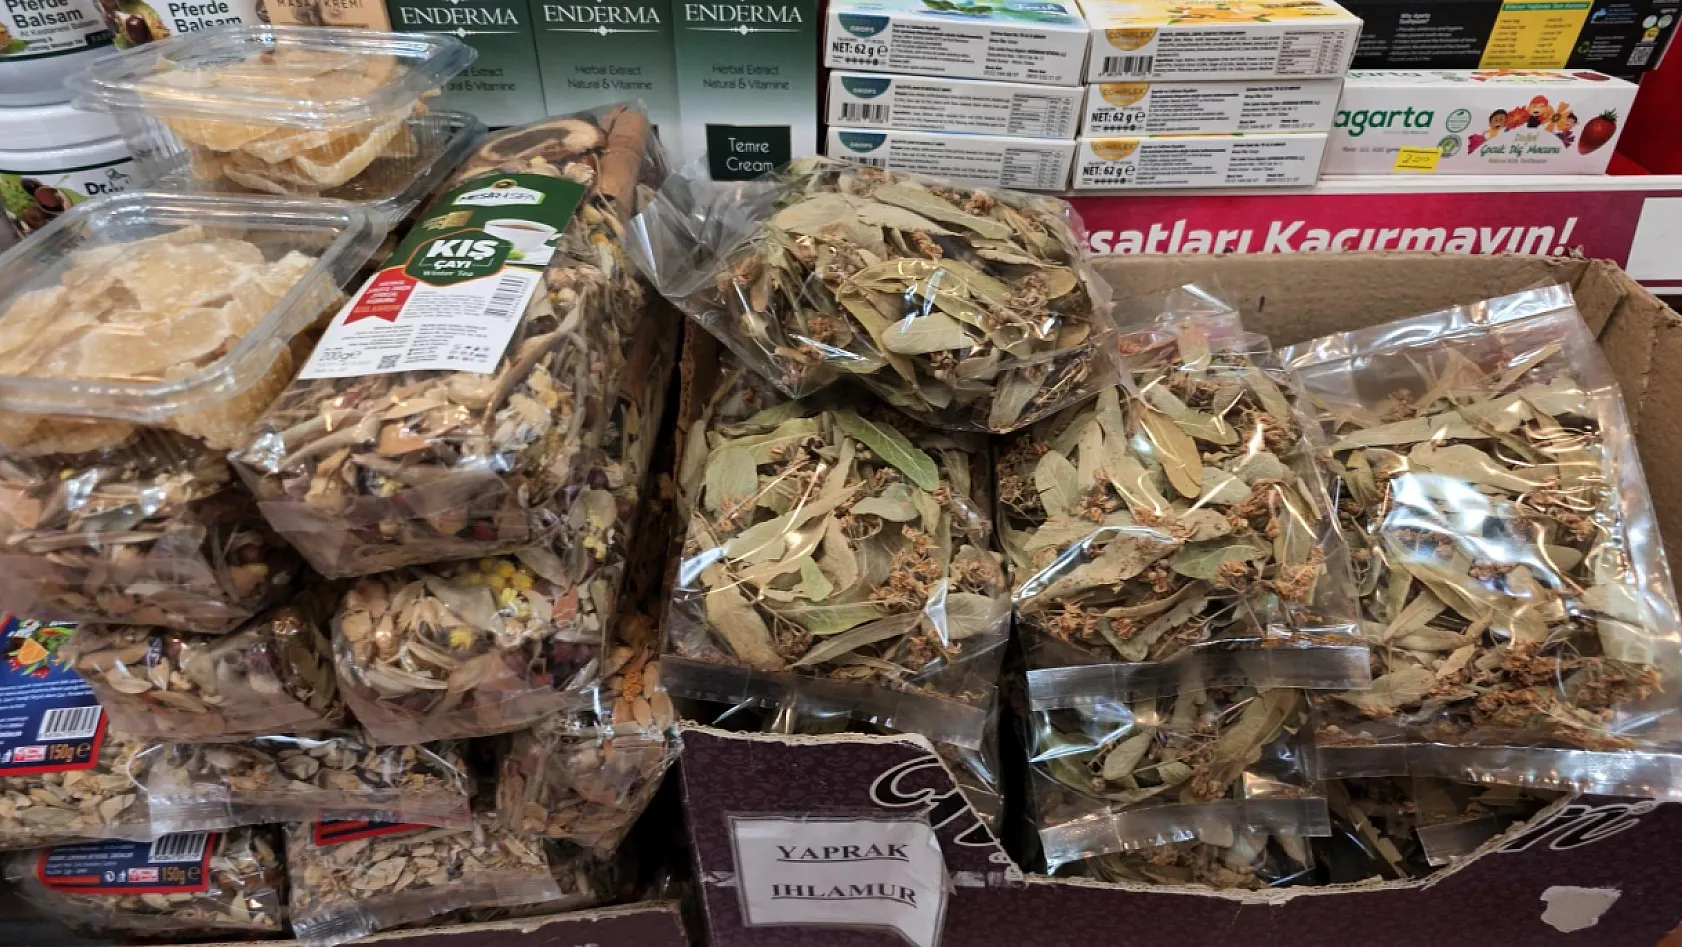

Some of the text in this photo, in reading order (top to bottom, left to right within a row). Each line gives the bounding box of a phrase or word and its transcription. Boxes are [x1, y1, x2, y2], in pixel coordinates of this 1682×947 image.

[169, 1, 229, 17] Pferde
[400, 7, 519, 25] ENDERMA
[543, 5, 661, 23] ENDERMA
[684, 3, 803, 23] ENDERMA
[12, 9, 83, 28] Balsam
[832, 42, 853, 53] NET:
[854, 43, 866, 54] 62
[609, 64, 642, 75] Extract
[746, 63, 779, 75] Extract
[1091, 112, 1112, 123] NET:
[1112, 112, 1125, 122] 62
[1333, 106, 1435, 137] agarta
[728, 137, 770, 152] Temre
[726, 156, 774, 171] Cream
[1082, 166, 1102, 176] NET:
[1103, 166, 1115, 175] 62
[1086, 219, 1253, 255] satları
[426, 239, 500, 260] KIŞ
[433, 260, 472, 269] ÇAYI
[50, 744, 75, 762] 150g
[776, 843, 909, 860] YAPRAK
[162, 866, 185, 884] 150g
[772, 884, 916, 902] IHLAMUR
